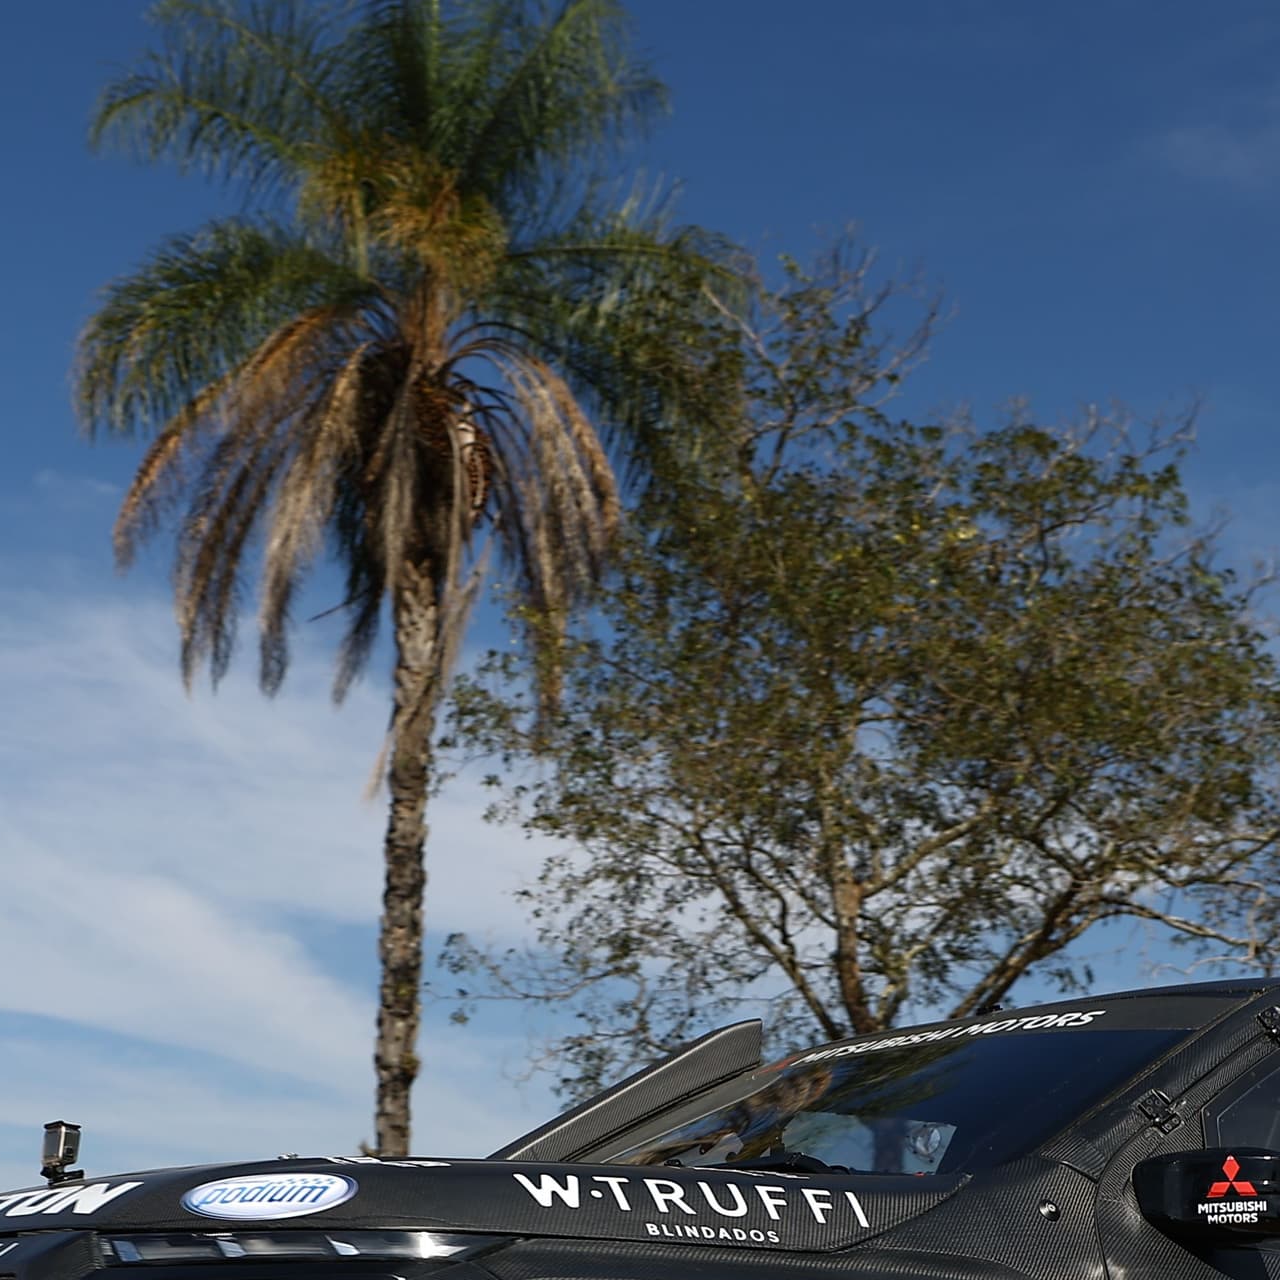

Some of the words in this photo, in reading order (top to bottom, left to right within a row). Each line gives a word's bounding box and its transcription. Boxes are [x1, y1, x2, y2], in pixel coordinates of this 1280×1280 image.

[790, 1027, 964, 1067] MITSUBISHI
[961, 1009, 1106, 1037] MOTORS
[198, 1182, 332, 1206] podium
[1197, 1200, 1267, 1215] MITSUBISHI
[1207, 1212, 1259, 1225] MOTORS
[645, 1222, 781, 1243] BLINDADOS
